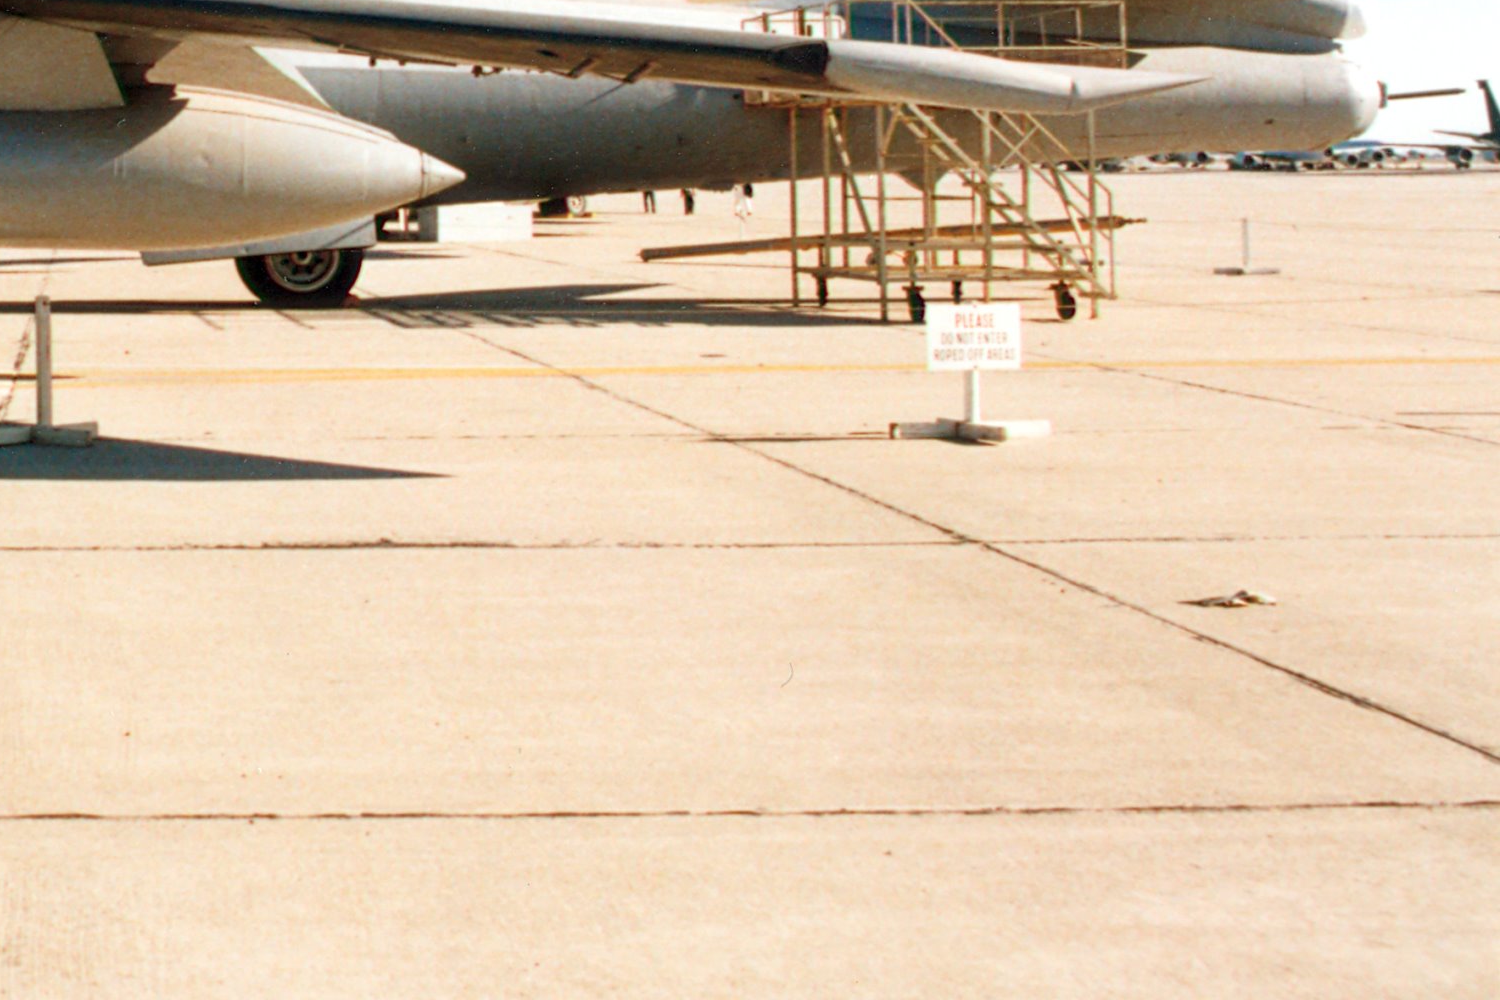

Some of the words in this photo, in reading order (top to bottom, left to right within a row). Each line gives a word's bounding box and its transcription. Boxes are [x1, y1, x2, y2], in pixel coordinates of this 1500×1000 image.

[954, 312, 995, 329] PLEASE
[941, 331, 954, 345] DO
[956, 331, 975, 345] NOT
[977, 331, 1008, 345] ENTER
[933, 347, 965, 361] ROPED
[967, 347, 984, 361] OFF
[986, 347, 1015, 361] AREAS
